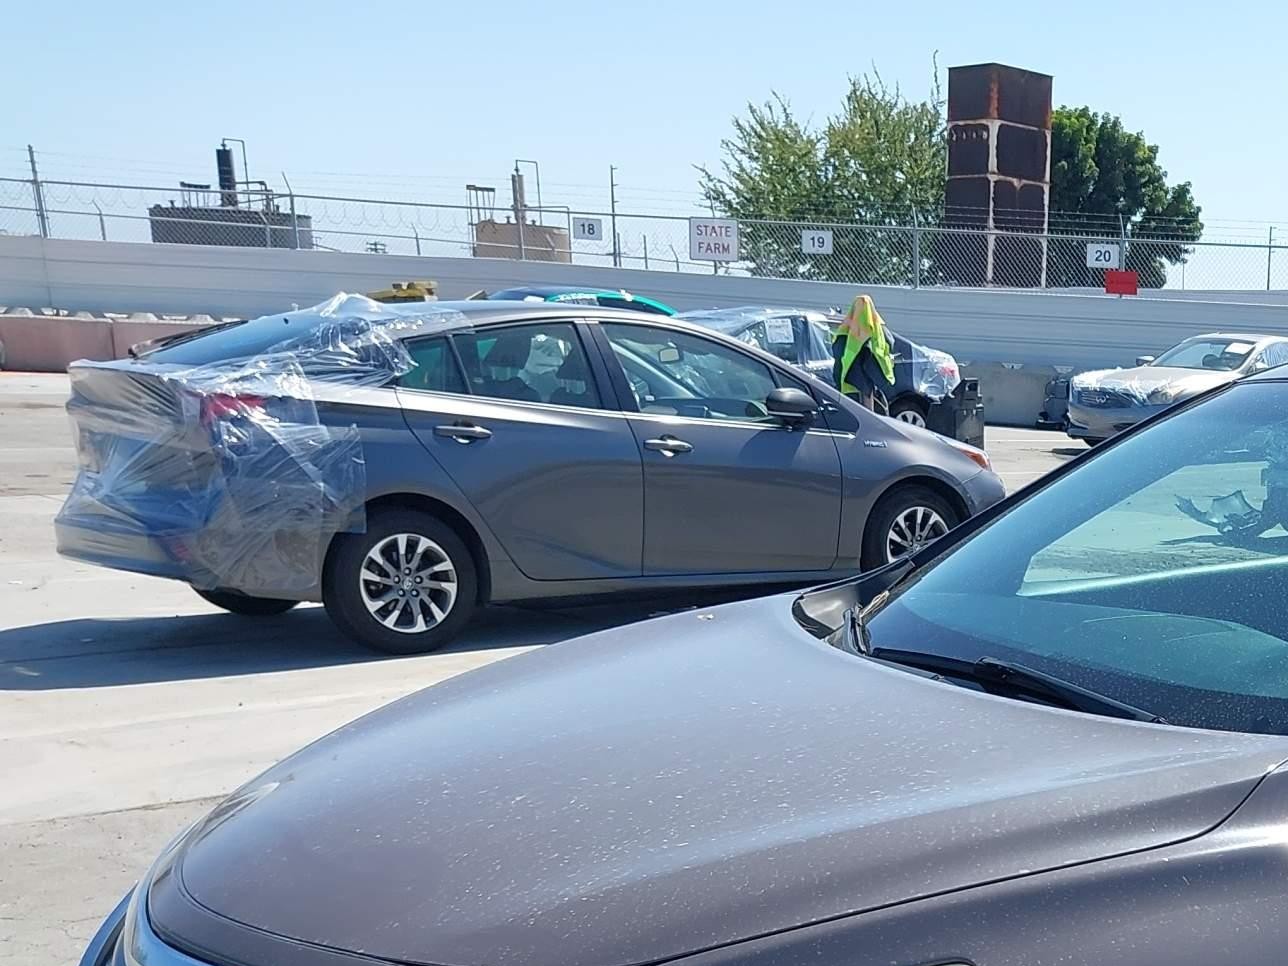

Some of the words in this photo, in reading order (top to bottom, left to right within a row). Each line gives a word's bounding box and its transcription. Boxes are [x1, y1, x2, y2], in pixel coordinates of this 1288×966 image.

[580, 223, 595, 235] 18
[696, 225, 731, 237] STATE
[810, 236, 825, 248] 19
[697, 242, 730, 255] FARM
[1095, 250, 1111, 262] 20
